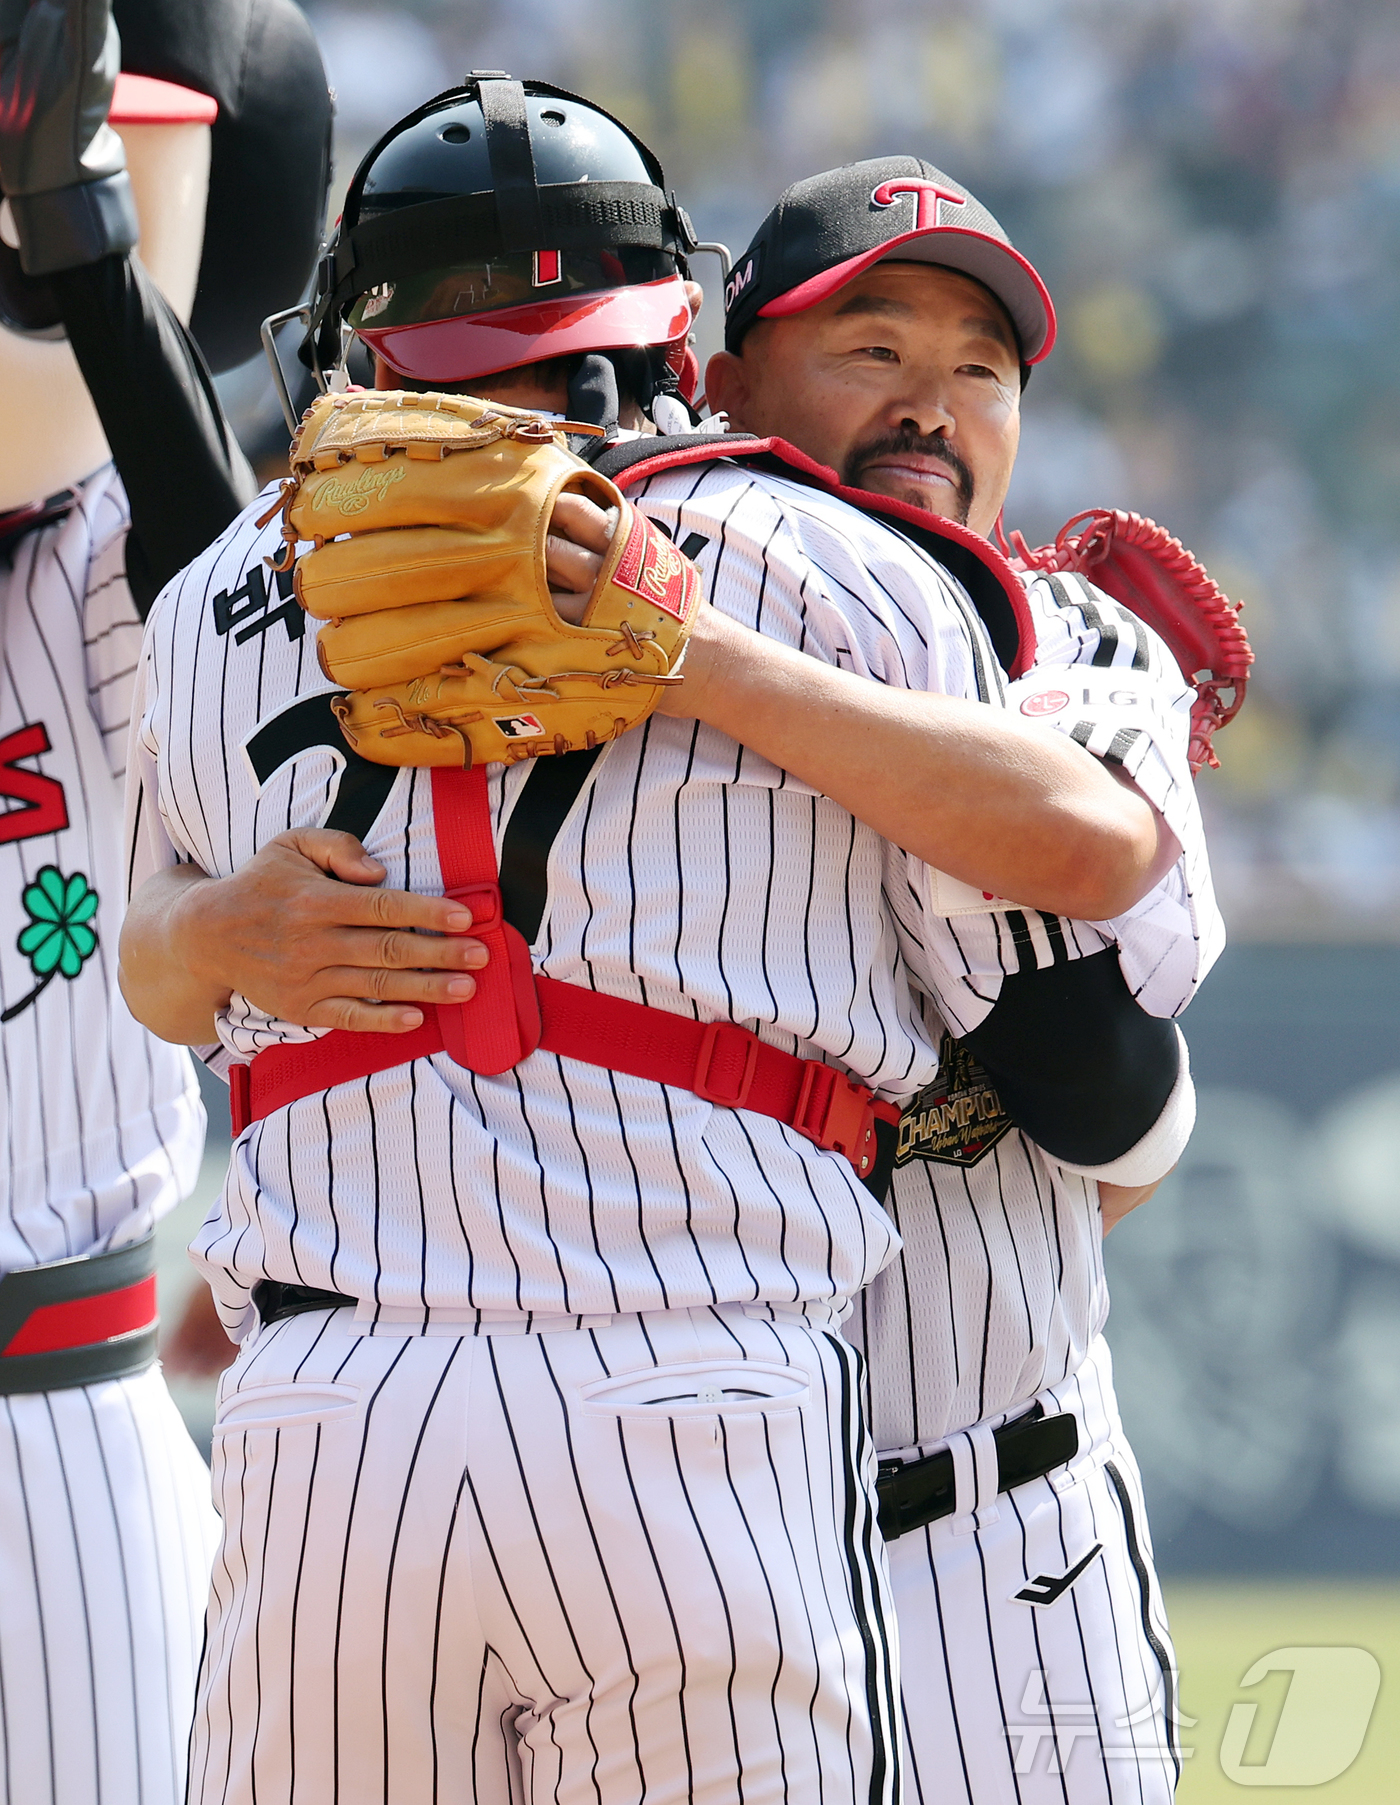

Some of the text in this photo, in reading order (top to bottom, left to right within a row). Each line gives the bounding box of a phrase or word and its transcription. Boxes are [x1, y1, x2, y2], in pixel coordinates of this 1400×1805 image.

[871, 178, 967, 231] T
[311, 466, 406, 512] Rawlings
[1082, 688, 1138, 706] LG
